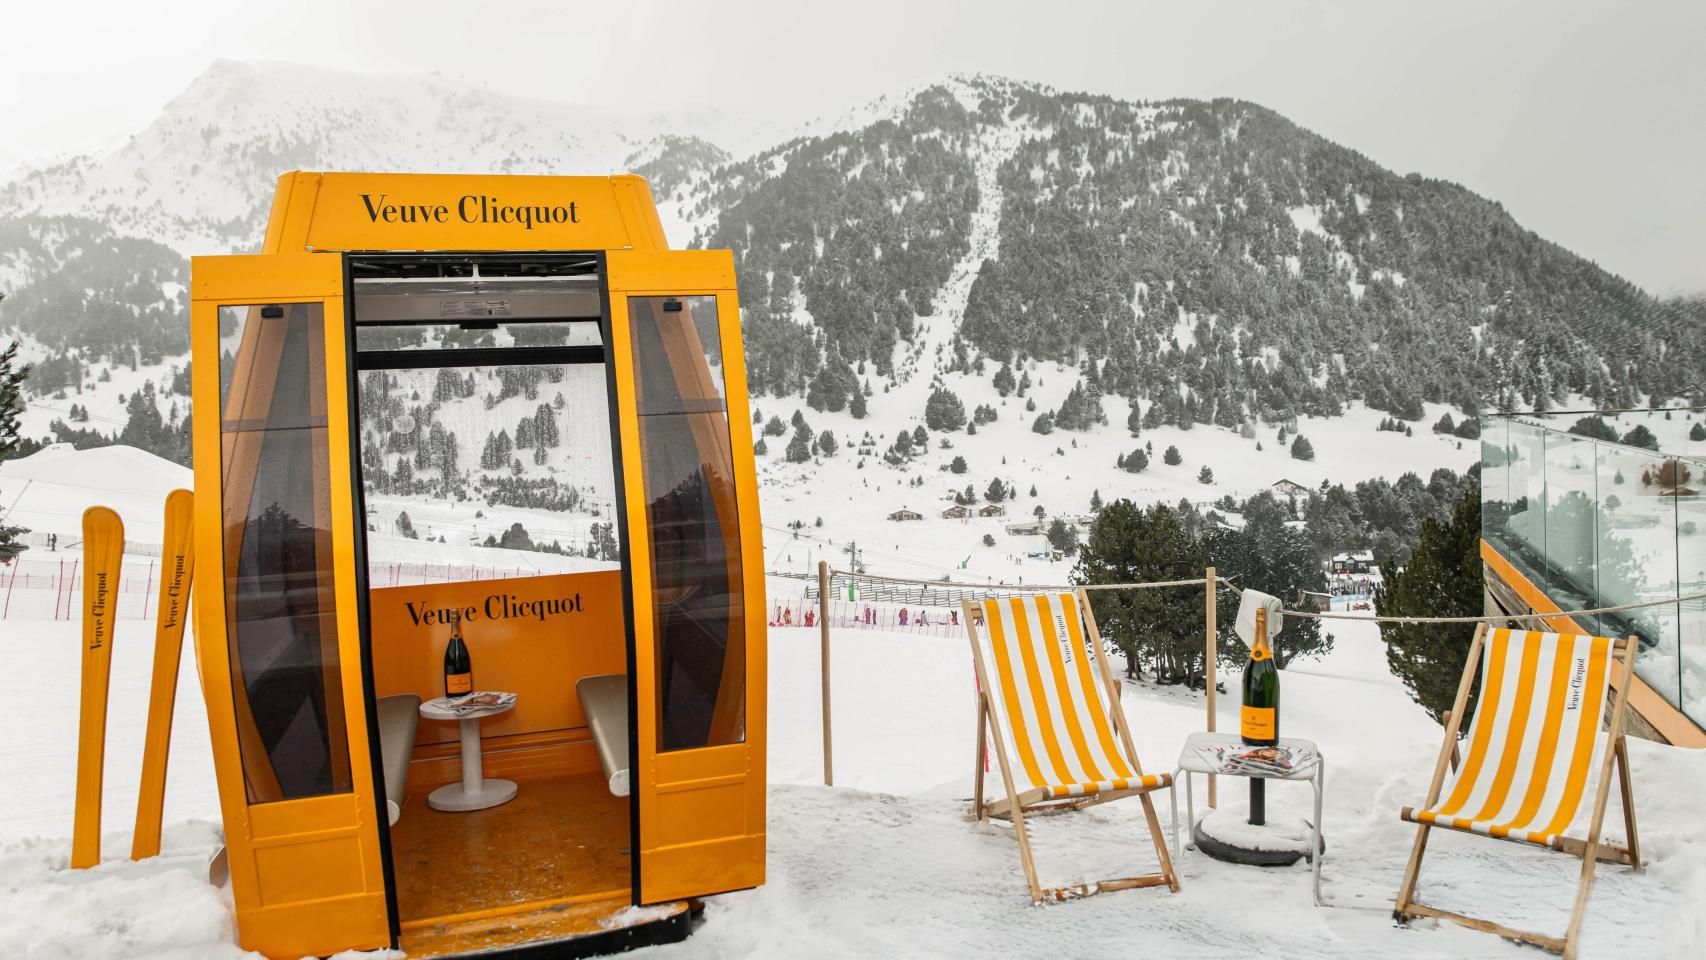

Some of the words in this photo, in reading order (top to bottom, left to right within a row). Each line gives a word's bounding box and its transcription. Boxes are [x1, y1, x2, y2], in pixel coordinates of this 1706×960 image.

[359, 194, 449, 223] Veuve
[458, 195, 581, 230] Clicquot
[164, 599, 179, 629] Veuve
[484, 592, 584, 622] Clicquot
[90, 619, 104, 650] Veuve
